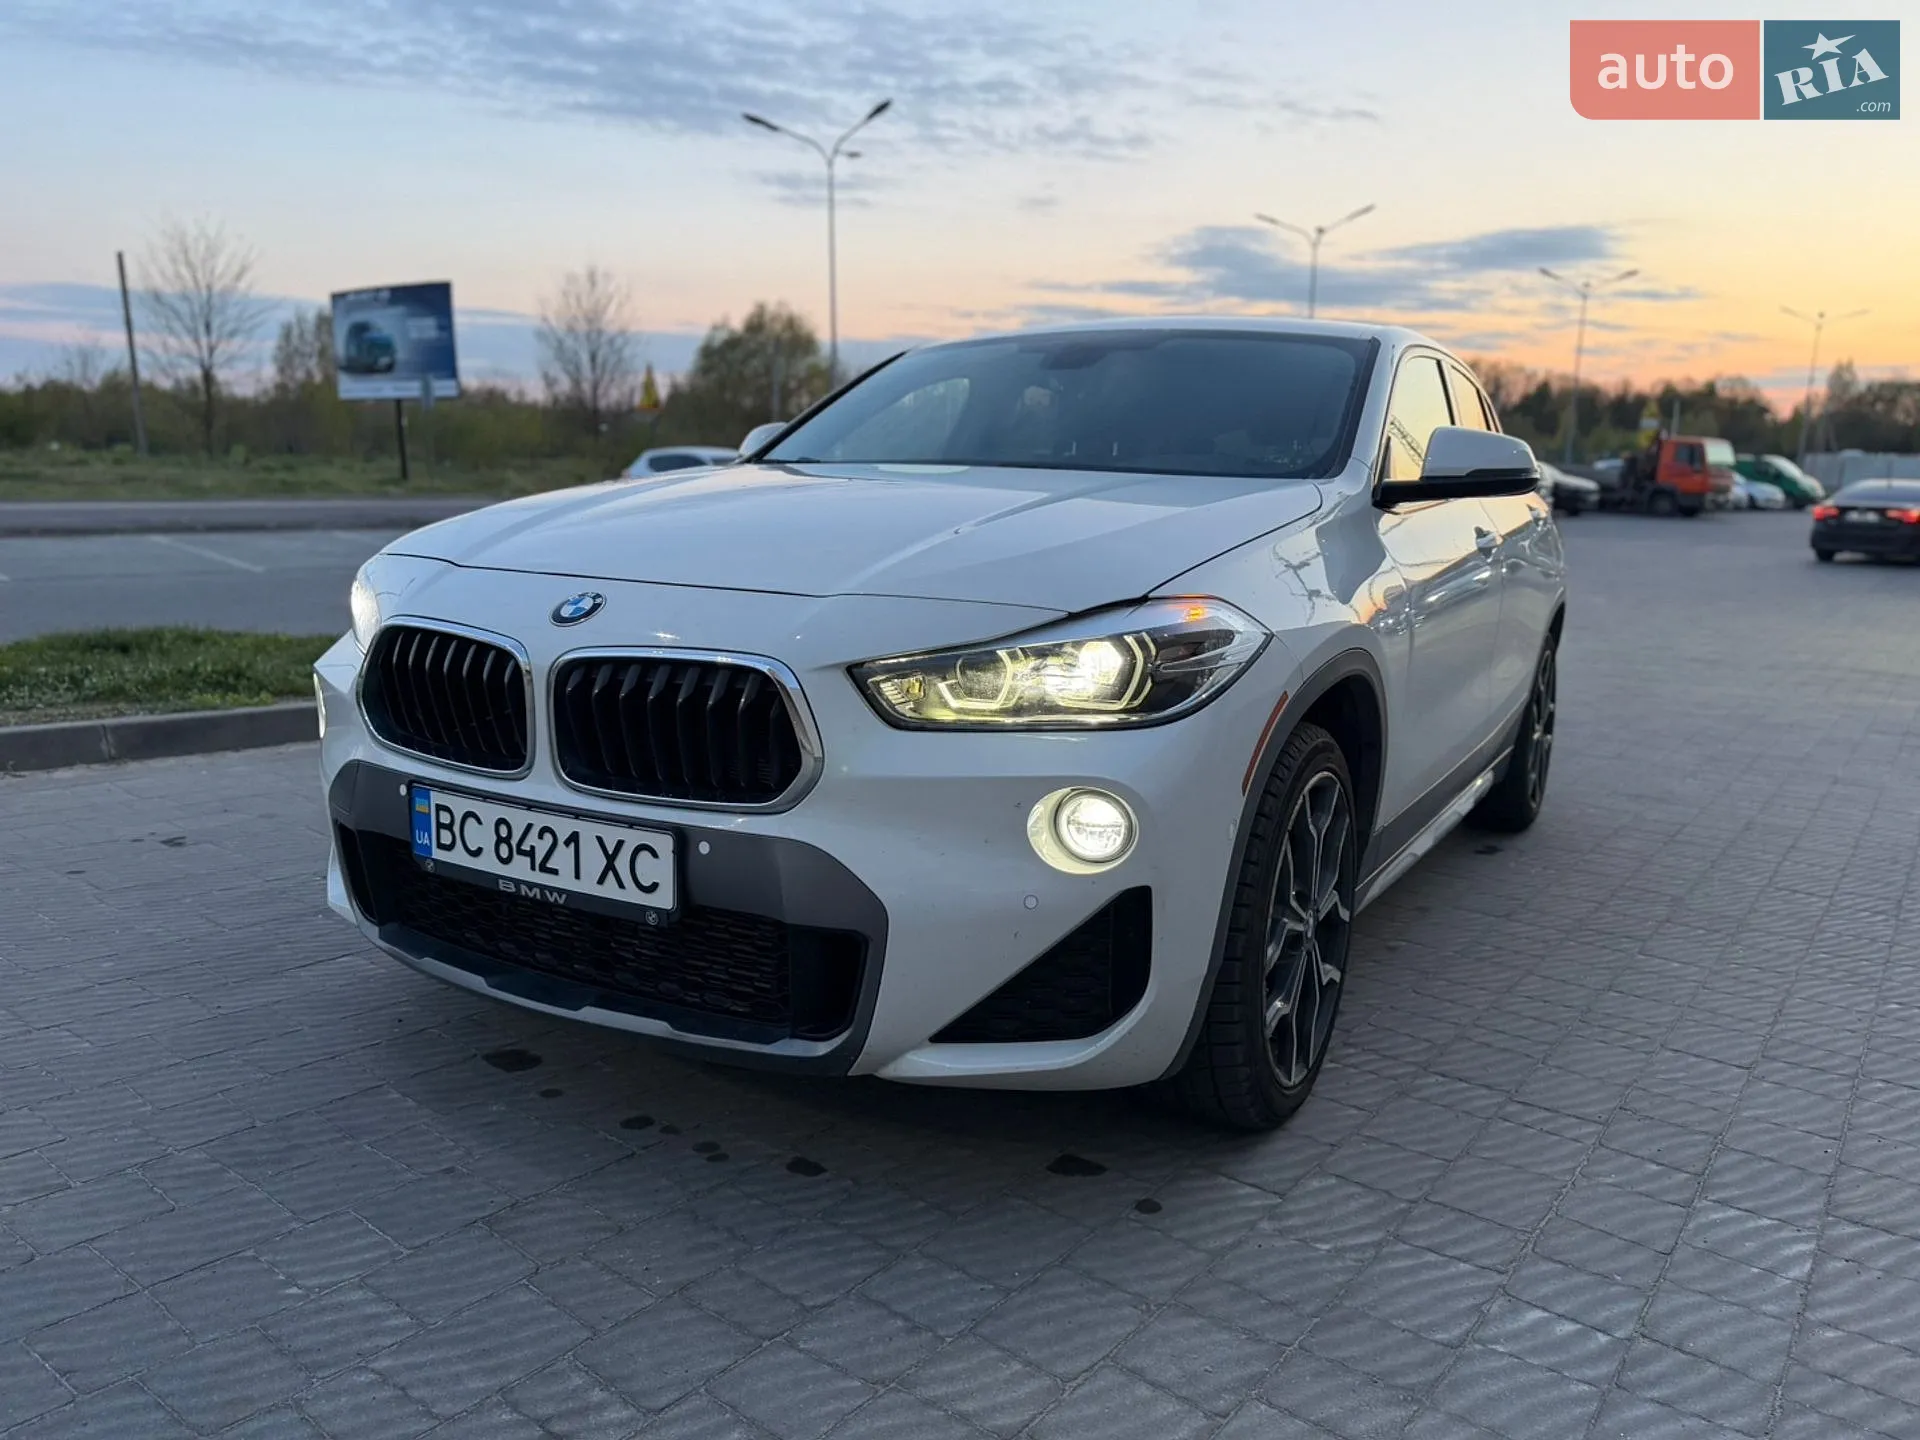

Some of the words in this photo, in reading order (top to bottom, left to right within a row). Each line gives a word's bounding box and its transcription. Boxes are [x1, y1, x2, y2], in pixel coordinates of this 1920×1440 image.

[415, 830, 431, 847] UA
[435, 803, 484, 858] BC
[494, 817, 581, 880] 8421
[595, 835, 660, 894] XC
[497, 879, 568, 905] BMW
